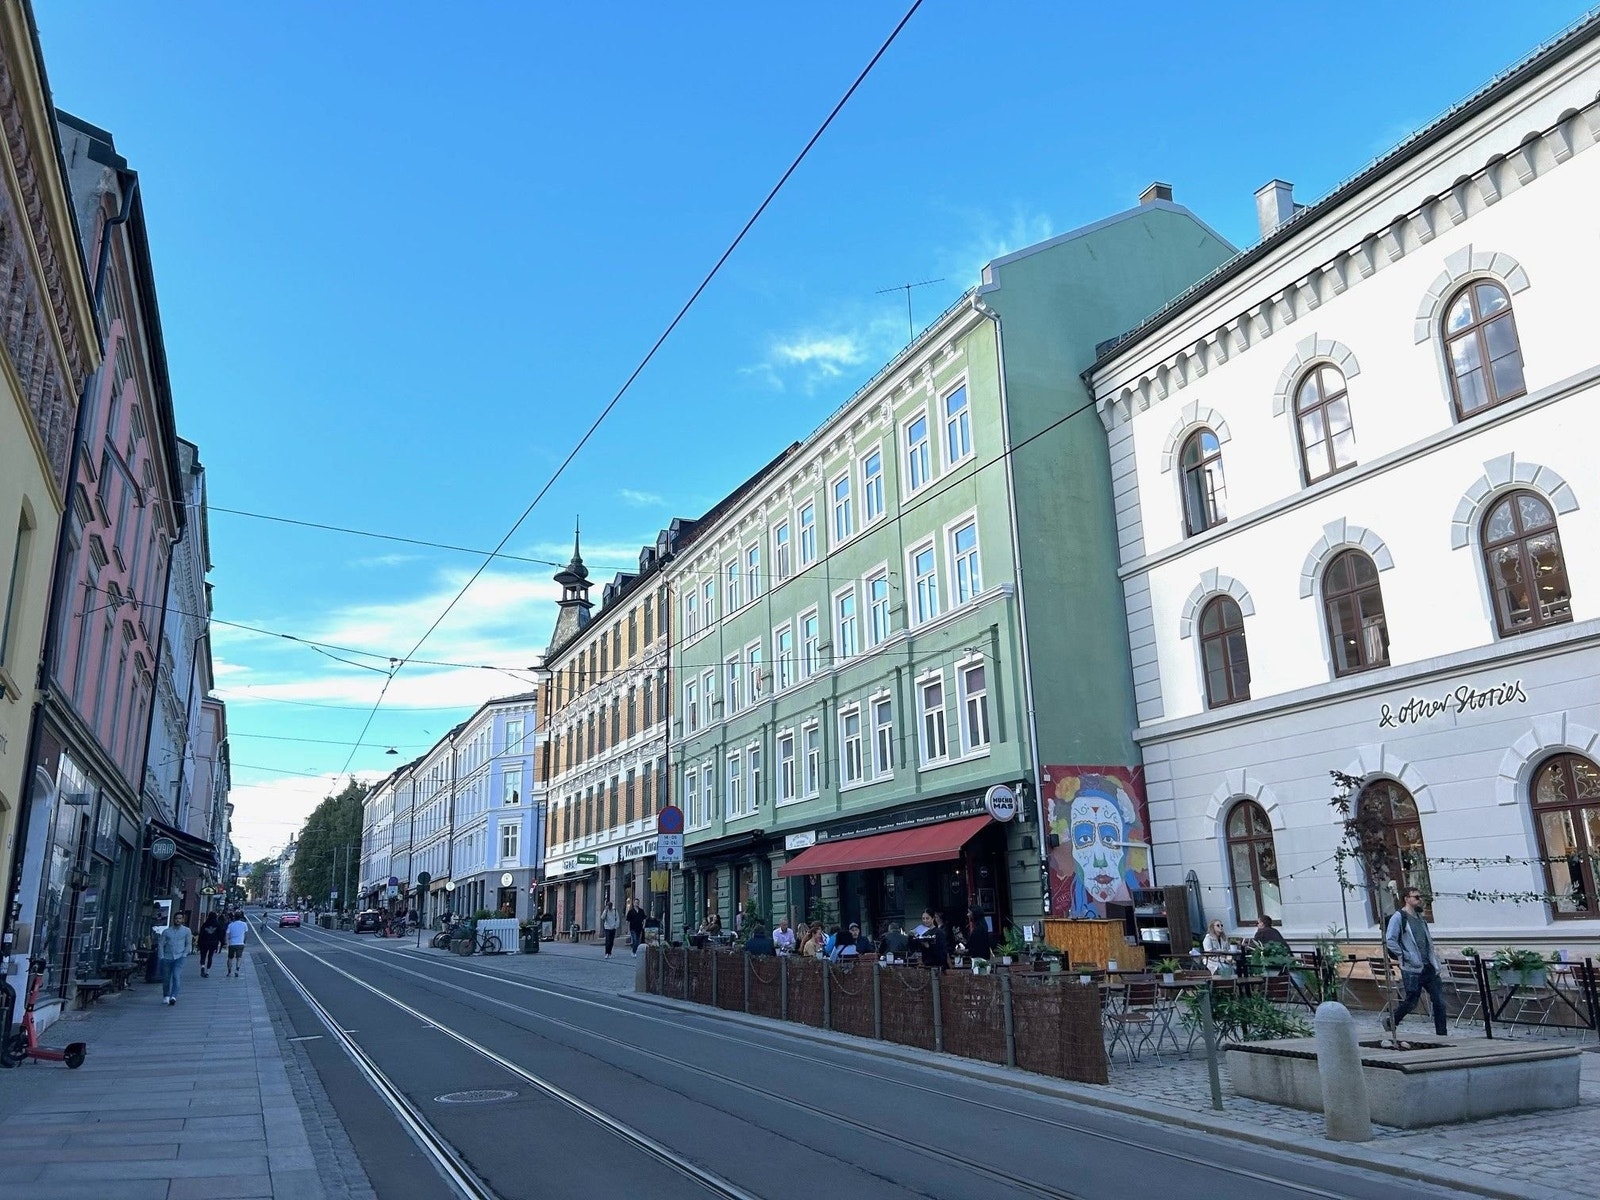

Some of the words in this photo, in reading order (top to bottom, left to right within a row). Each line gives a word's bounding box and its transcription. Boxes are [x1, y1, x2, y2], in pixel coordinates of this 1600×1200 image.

[1379, 704, 1397, 728] &
[1398, 694, 1451, 724] other
[1454, 680, 1527, 714] Stories
[153, 843, 174, 854] CHAIR
